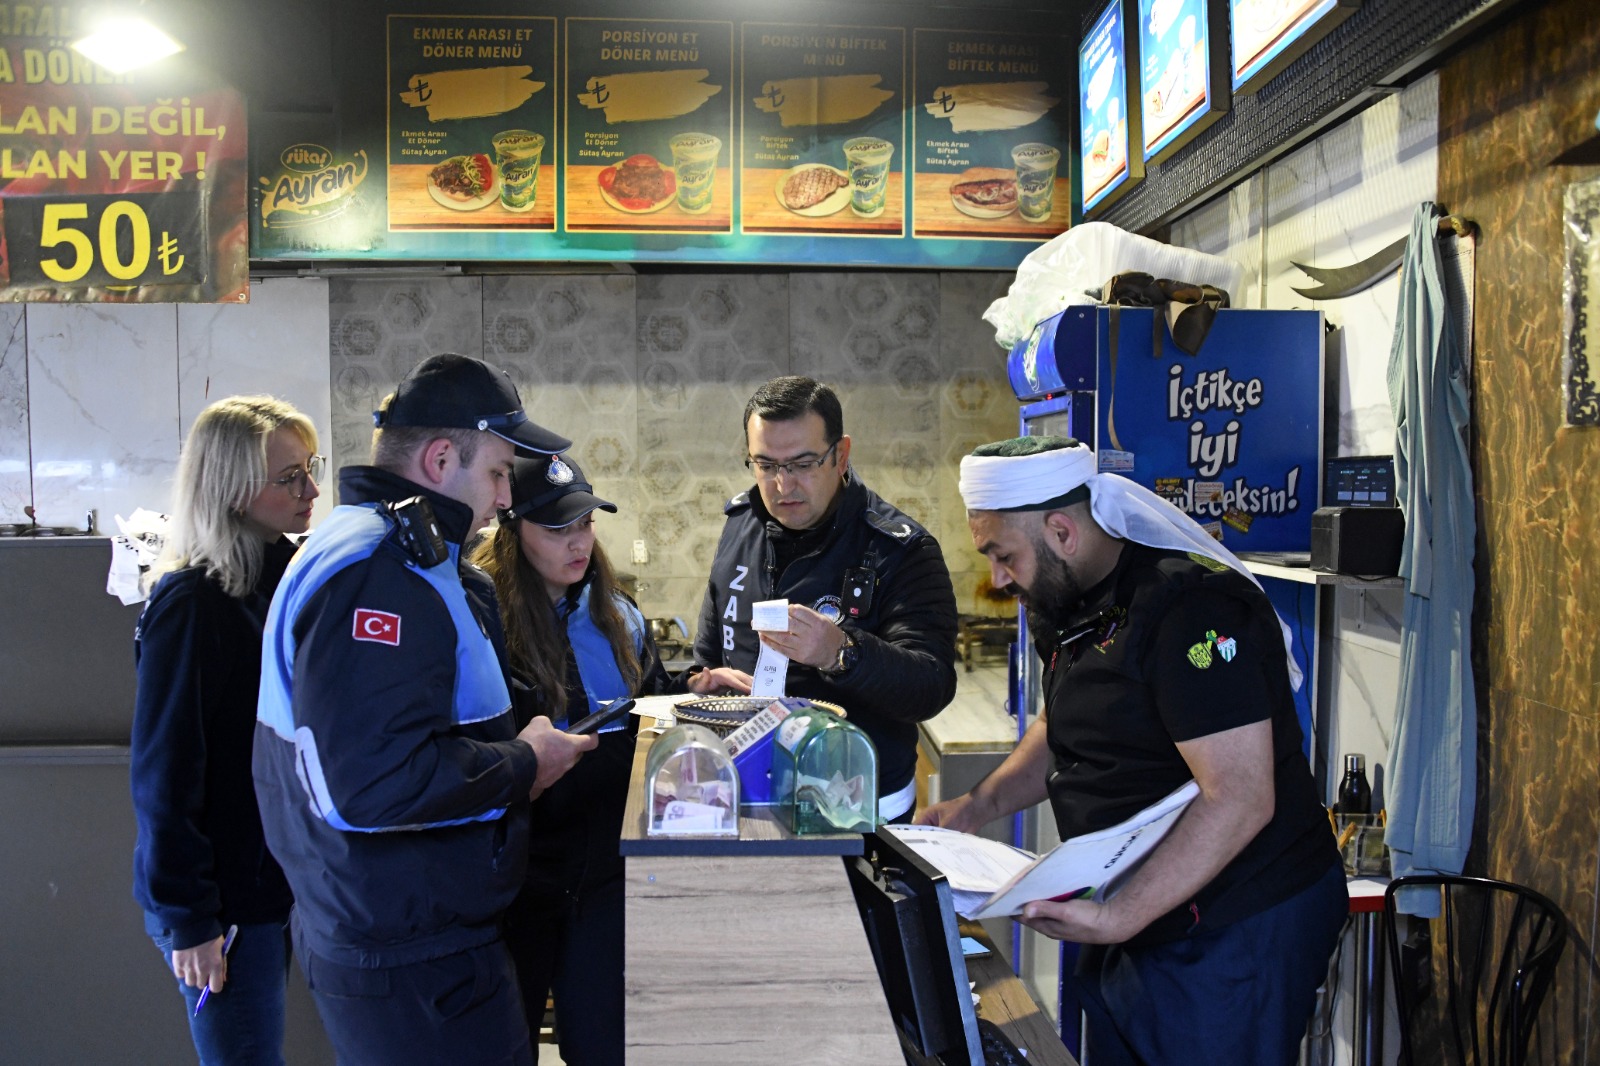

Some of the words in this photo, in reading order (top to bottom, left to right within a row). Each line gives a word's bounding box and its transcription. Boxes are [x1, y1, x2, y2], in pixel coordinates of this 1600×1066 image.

[413, 27, 464, 40] EKMEK
[467, 28, 511, 41] ARASI
[515, 28, 533, 41] ET
[602, 28, 678, 43] PORSİYON
[682, 32, 699, 44] ET
[423, 42, 474, 58] DÖNER
[478, 43, 522, 59] MENÜ
[601, 45, 651, 60] DÖNER
[656, 47, 699, 62] MENÜ
[948, 41, 995, 55] EKMEK
[803, 52, 846, 66] MNÜ
[91, 97, 226, 141] DEĞİL,
[98, 150, 183, 180] YER
[286, 148, 327, 168] sütaş
[273, 164, 354, 209] Ayran
[1170, 364, 1262, 418] İçtikçe
[1191, 421, 1239, 477] iyi
